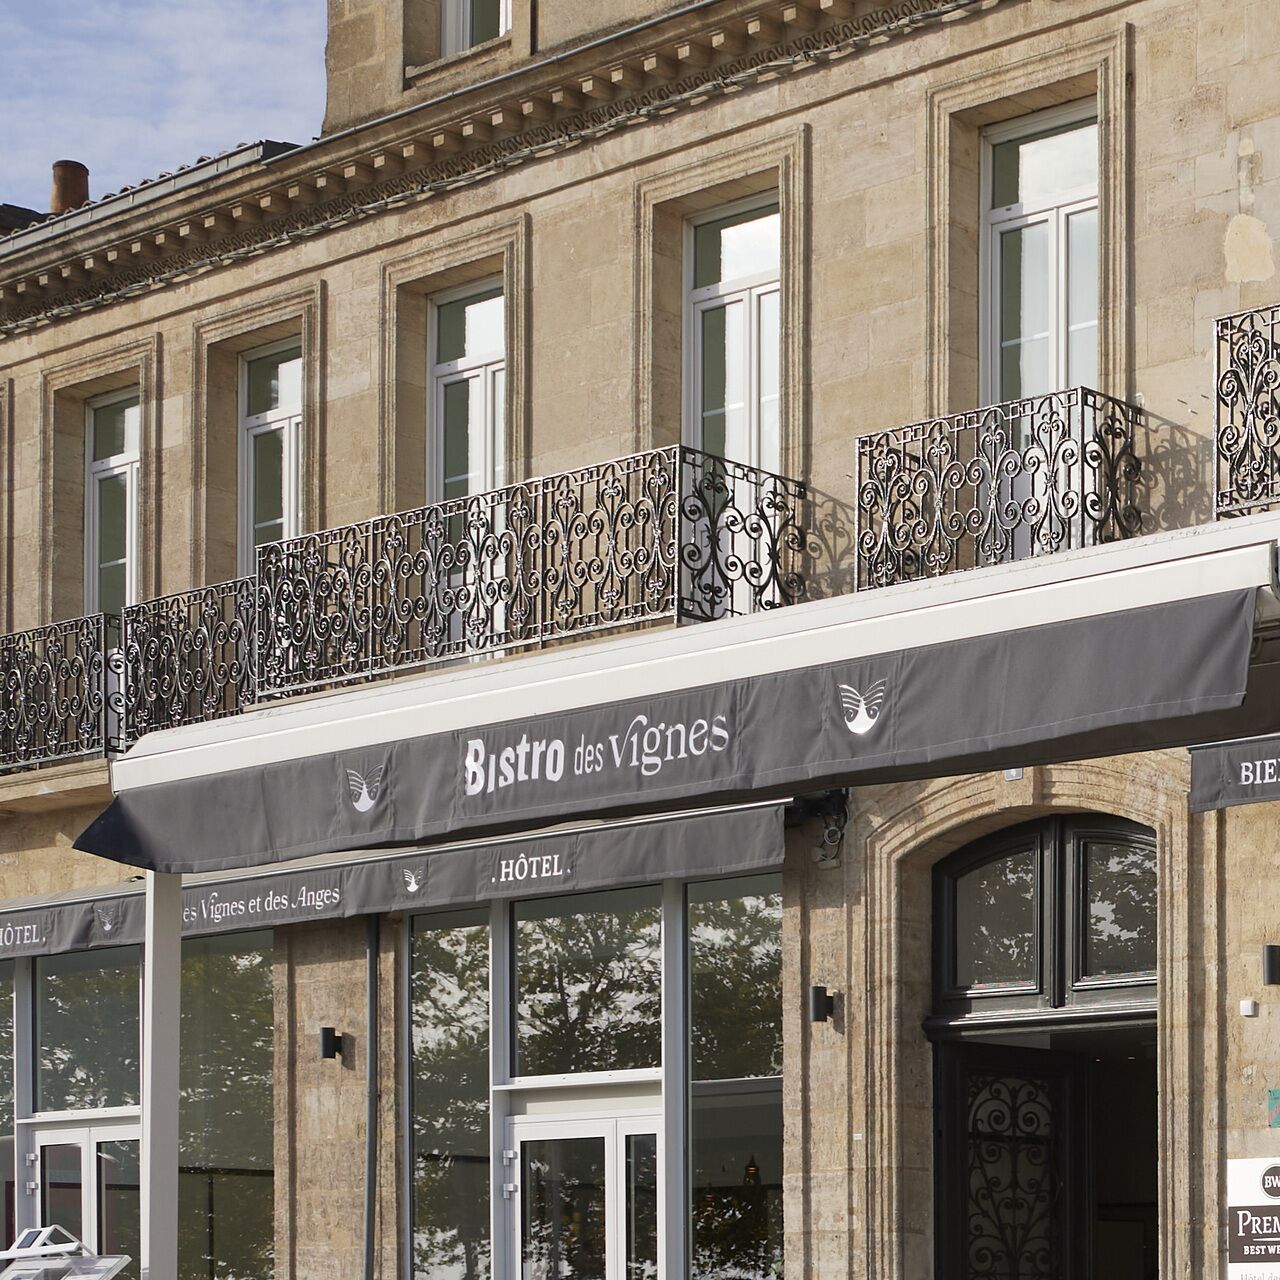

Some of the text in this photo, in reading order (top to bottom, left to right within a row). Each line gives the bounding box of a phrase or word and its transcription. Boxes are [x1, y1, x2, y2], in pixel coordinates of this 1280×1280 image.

[464, 714, 729, 796] Bistro des Vignes
[499, 852, 563, 882] HÔTEL
[182, 885, 340, 923] es Vignes et des Anges
[1243, 1245, 1267, 1255] BEST
